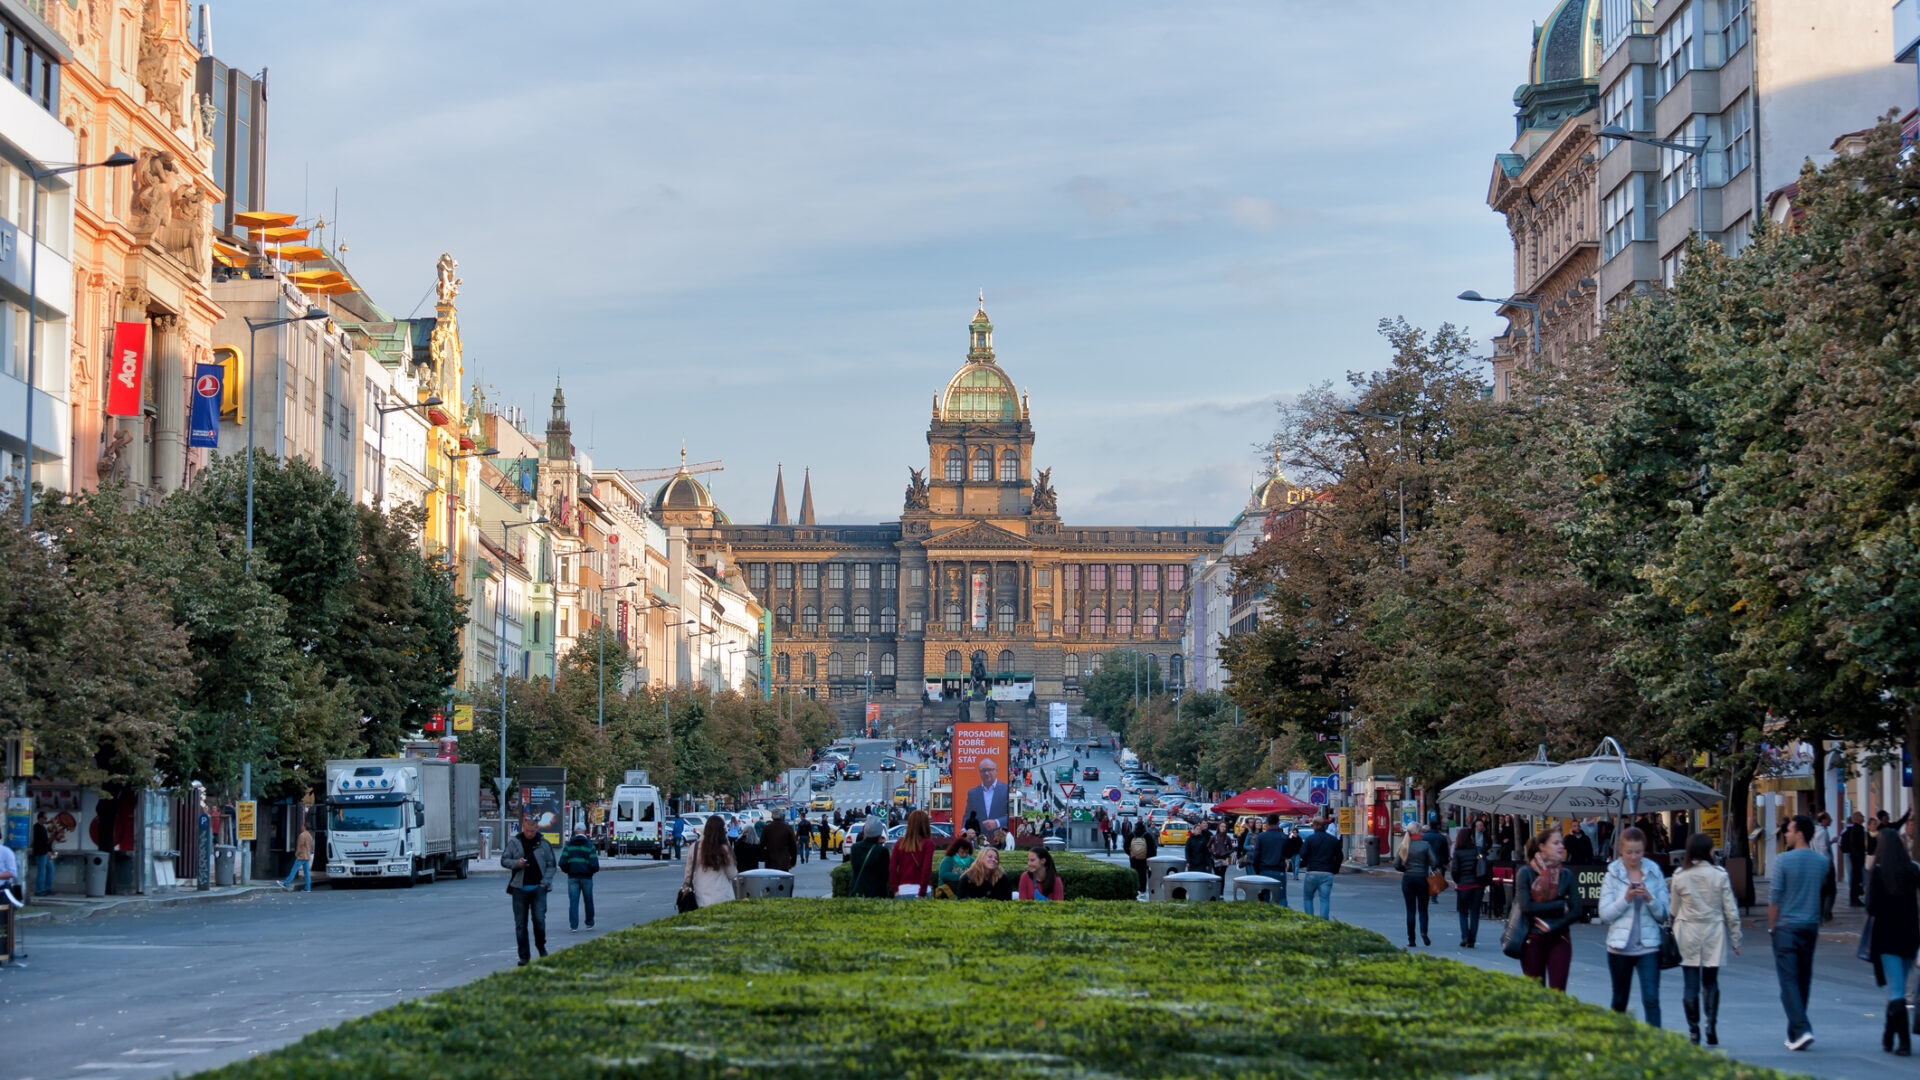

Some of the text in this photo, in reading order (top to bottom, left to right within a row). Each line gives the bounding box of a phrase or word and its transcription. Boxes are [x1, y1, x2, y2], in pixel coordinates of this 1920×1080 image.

[118, 349, 137, 388] AON
[958, 728, 1005, 738] PROSADÍME
[958, 738, 985, 746] DOBŘE
[958, 746, 1000, 755] FUNGUJÍCÍ
[958, 755, 977, 763] STÁT
